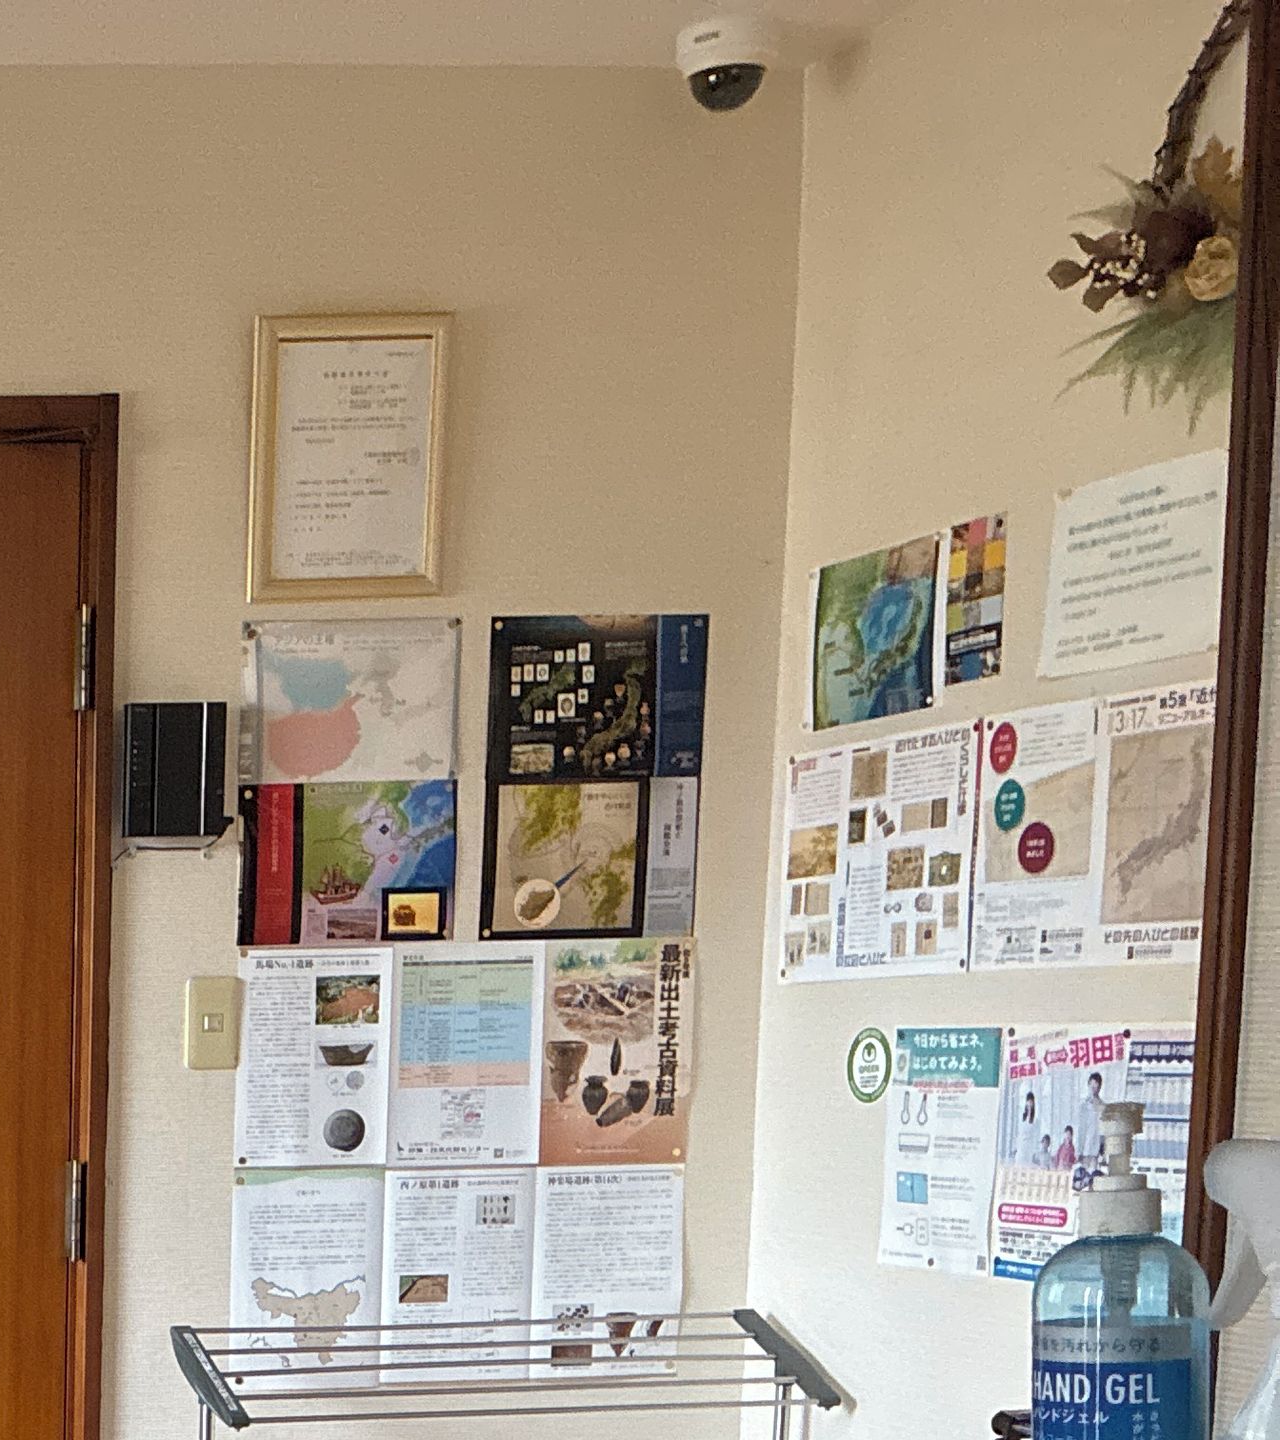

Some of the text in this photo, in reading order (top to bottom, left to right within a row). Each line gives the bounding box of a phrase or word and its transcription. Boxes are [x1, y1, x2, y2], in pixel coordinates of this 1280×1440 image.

[653, 944, 681, 1116] 最新出土考古資料展
[1069, 1035, 1113, 1068] 羽田
[1034, 1371, 1160, 1404] HAND GEL
